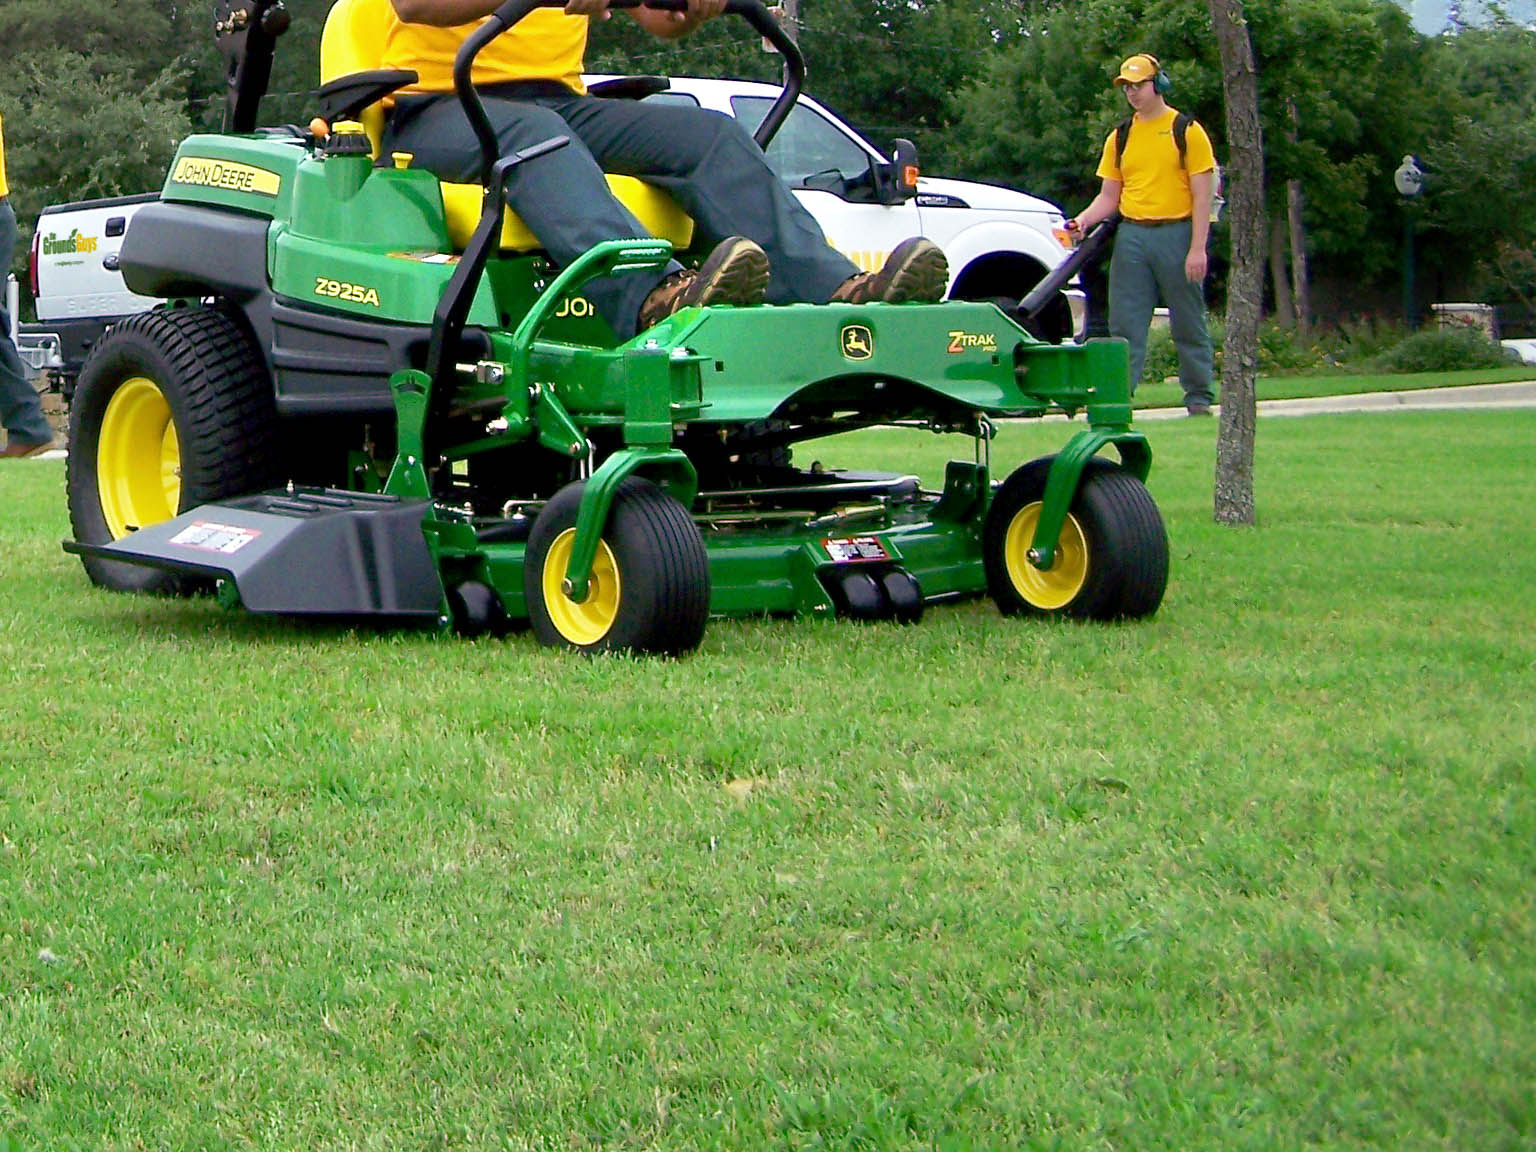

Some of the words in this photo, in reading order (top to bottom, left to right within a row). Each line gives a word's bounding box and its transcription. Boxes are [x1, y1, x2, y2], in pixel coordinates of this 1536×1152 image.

[178, 162, 211, 182] JOHN
[211, 164, 255, 188] DEERE
[314, 277, 380, 307] Z925A
